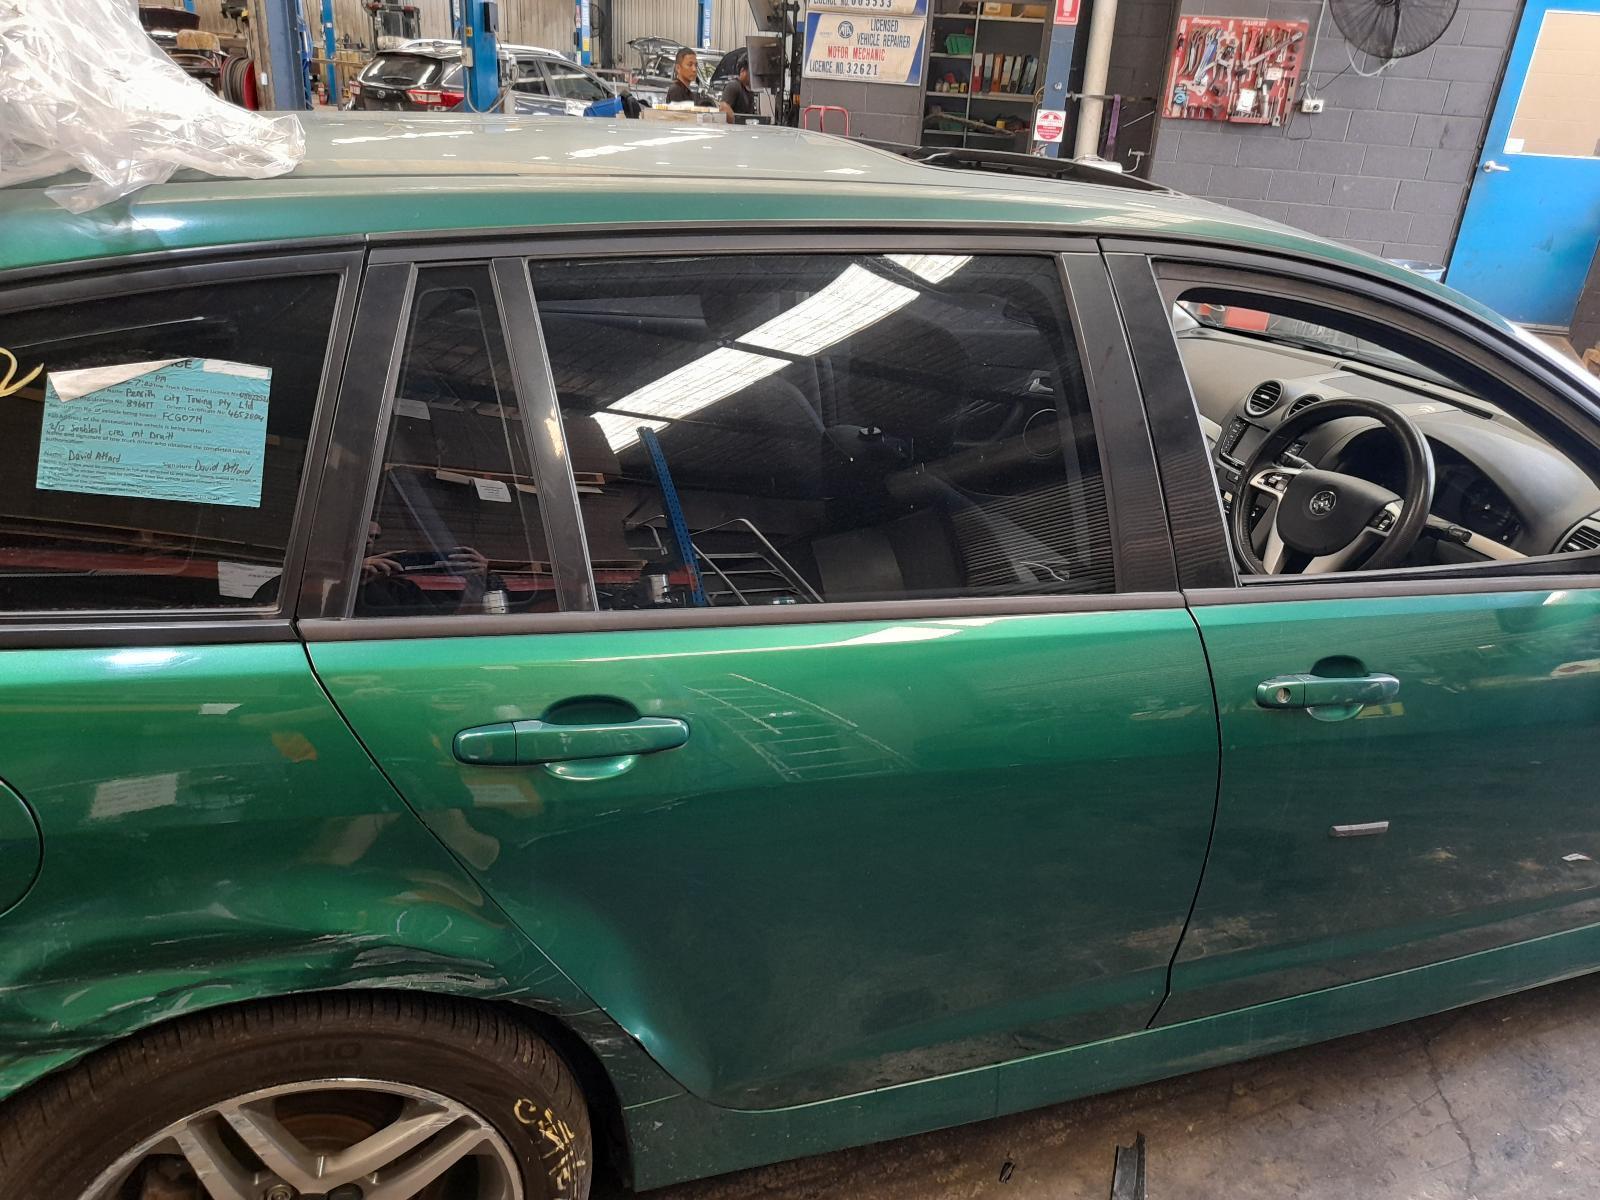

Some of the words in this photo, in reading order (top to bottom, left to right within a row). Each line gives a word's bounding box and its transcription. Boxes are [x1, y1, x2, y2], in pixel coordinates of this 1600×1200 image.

[871, 19, 898, 33] LICENSED
[857, 33, 880, 47] VEHICLE
[883, 35, 911, 48] REPAIRER
[828, 46, 848, 59] MOTOR
[853, 47, 886, 61] MECHANIC
[809, 60, 832, 74] LICENCE
[847, 62, 878, 75] 32621
[69, 449, 93, 461] David
[194, 459, 219, 471] David
